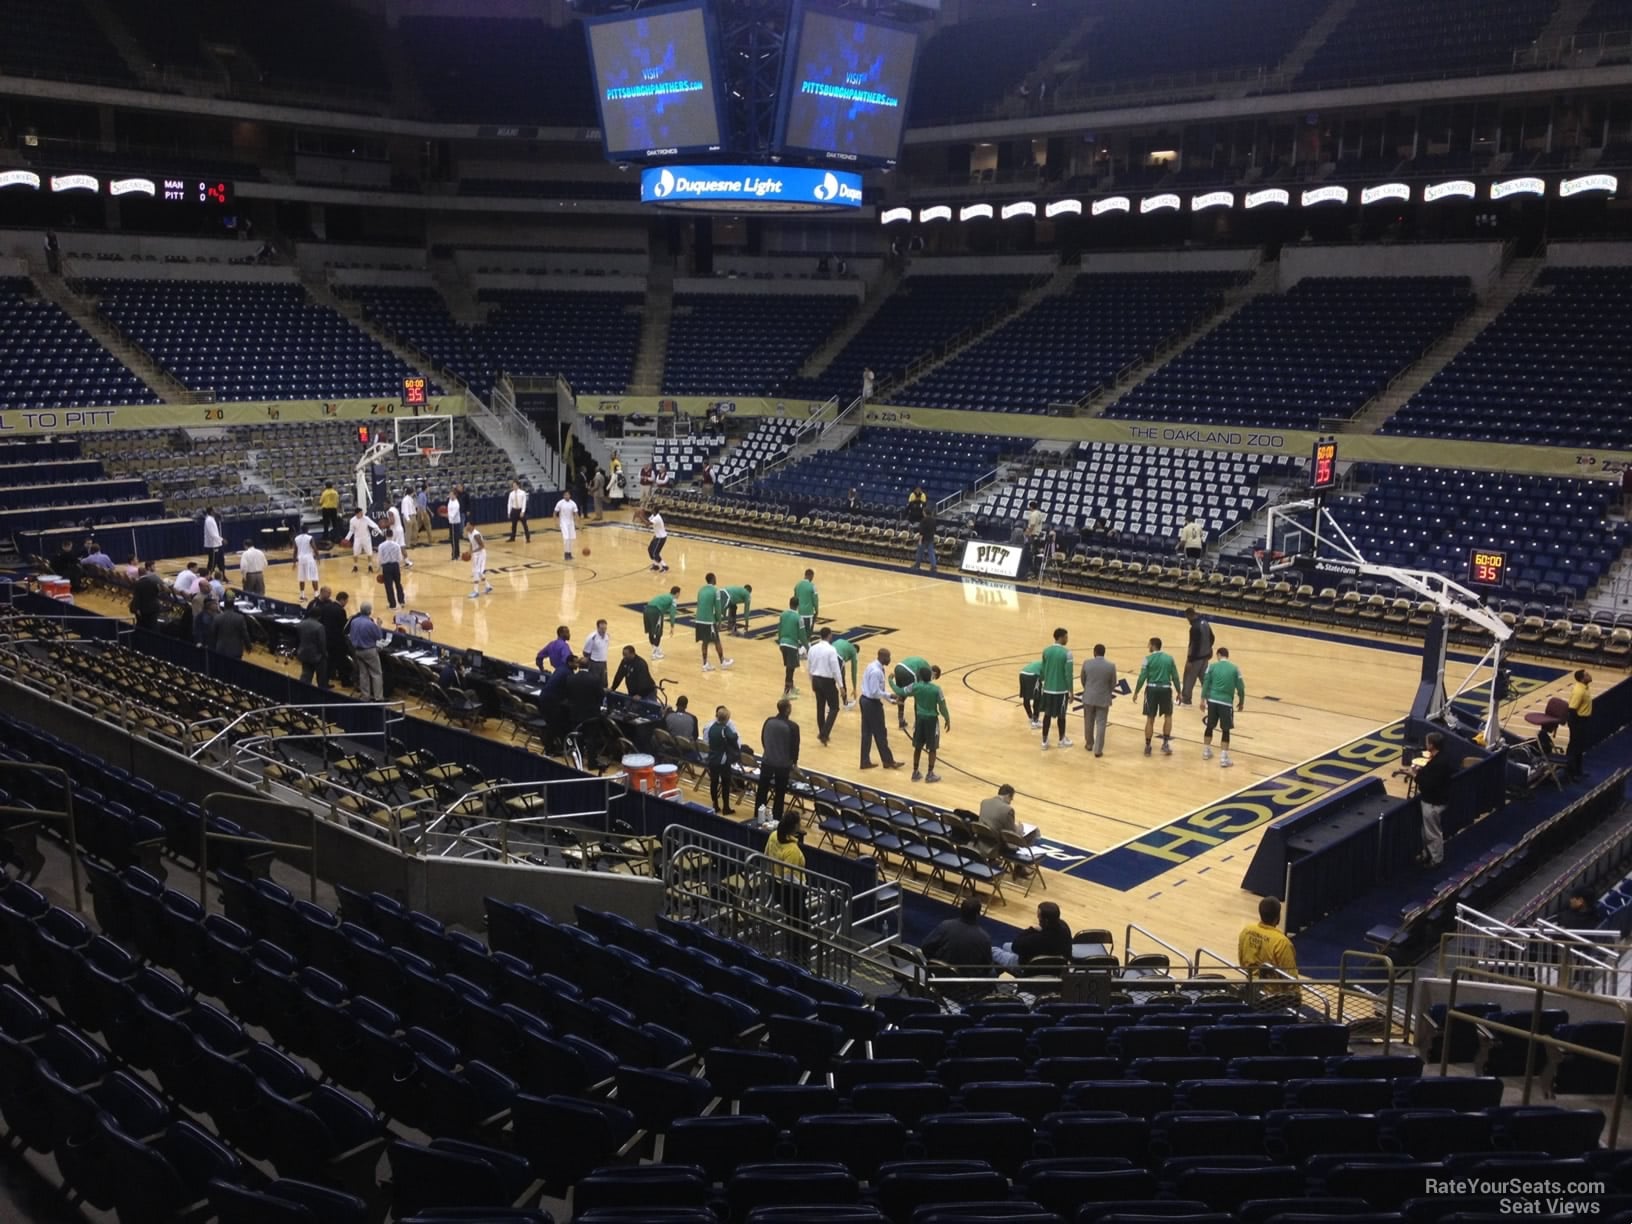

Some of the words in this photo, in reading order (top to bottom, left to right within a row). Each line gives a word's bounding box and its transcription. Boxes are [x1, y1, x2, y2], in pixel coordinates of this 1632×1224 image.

[642, 66, 660, 80] VISIT
[846, 72, 862, 85] VISIT
[164, 179, 184, 190] MAN
[199, 182, 206, 191] 0
[675, 178, 741, 195] Duquesne
[744, 177, 783, 196] Light
[165, 191, 185, 201] PITT
[199, 193, 206, 202] 0
[408, 388, 422, 402] 35
[22, 413, 57, 428] TO
[66, 411, 115, 426] PITT
[1129, 426, 1158, 439] THE
[1163, 429, 1242, 445] OAKLAND
[1247, 434, 1284, 448] ZOO
[977, 545, 1010, 566] PITT
[1475, 554, 1503, 567] 60:00
[1479, 565, 1497, 580] 35
